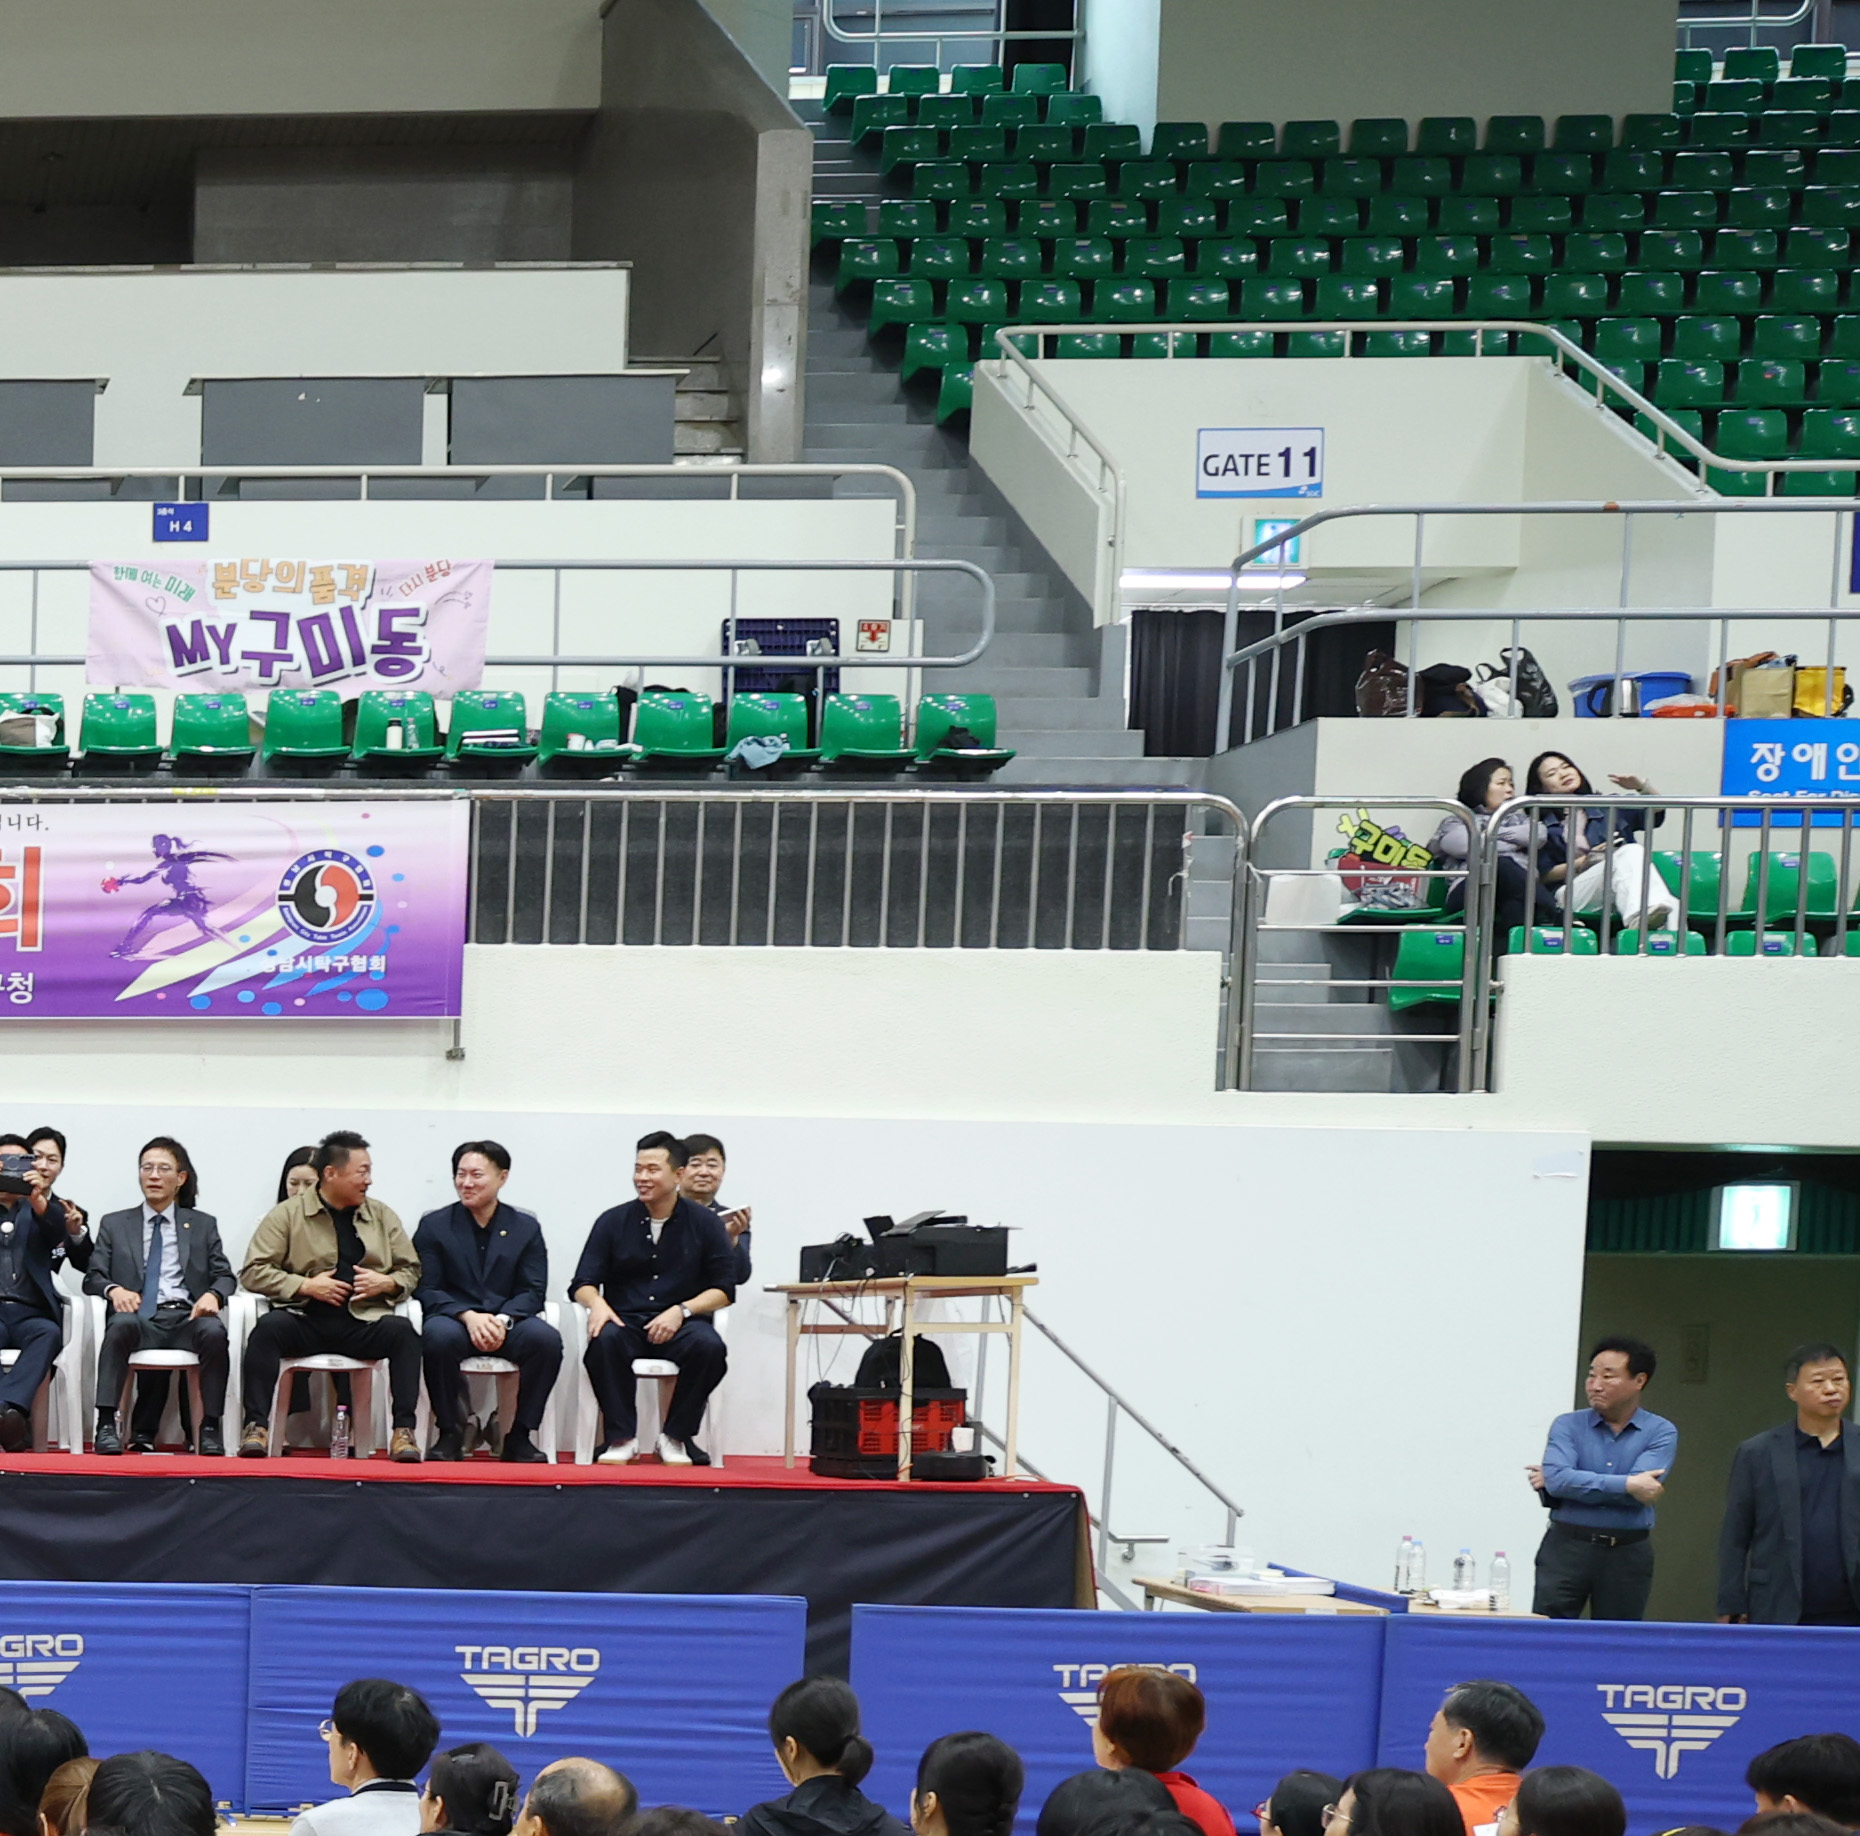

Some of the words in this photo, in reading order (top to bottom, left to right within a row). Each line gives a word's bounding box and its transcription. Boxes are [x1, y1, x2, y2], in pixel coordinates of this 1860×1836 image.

[1203, 453, 1270, 478] GATE
[1277, 446, 1317, 478] 11
[213, 558, 307, 600] 분당의
[309, 563, 368, 606] 품격
[166, 618, 238, 668] MY
[241, 604, 423, 678] 구미동
[455, 1645, 600, 1672] TAGRO
[1053, 1663, 1198, 1688] TAO
[1597, 1684, 1747, 1712] TAGRO
